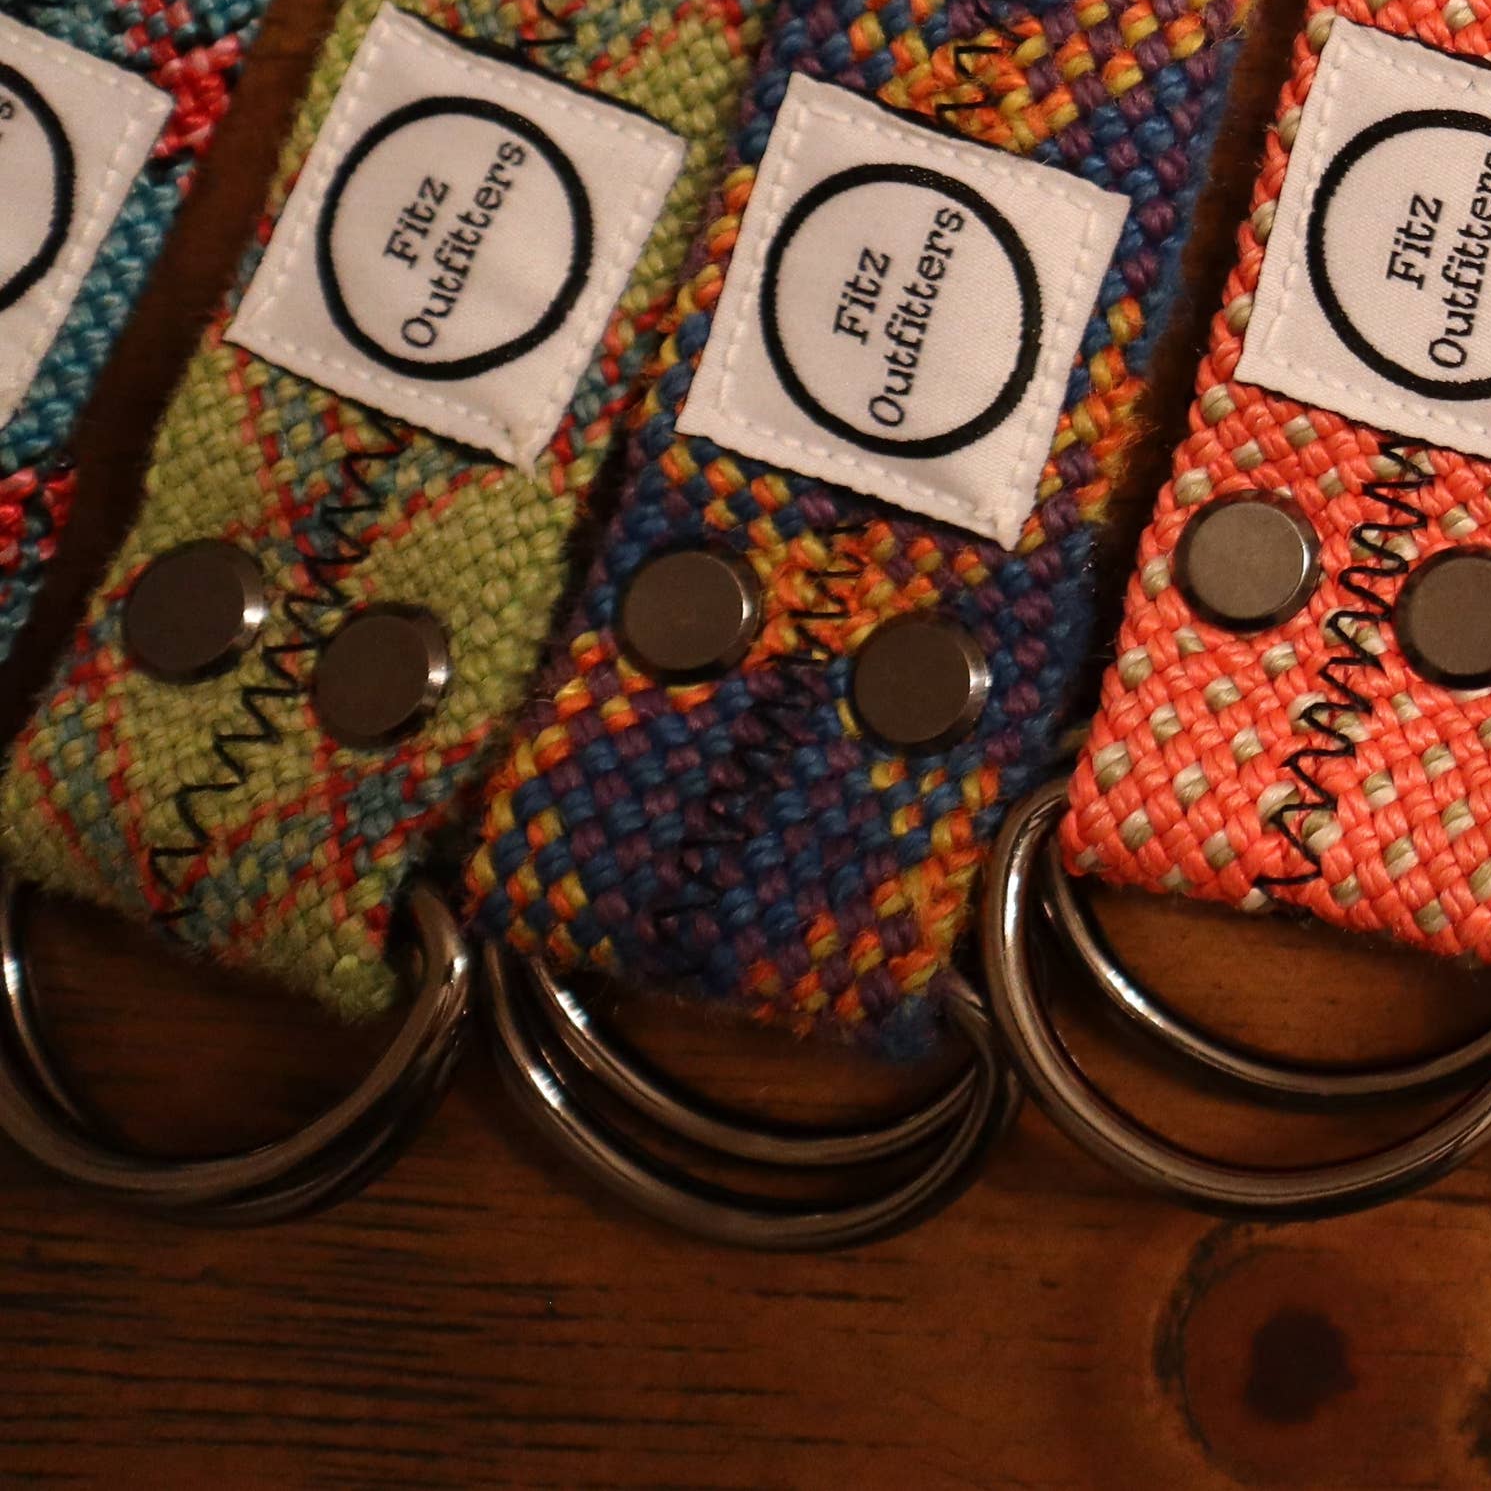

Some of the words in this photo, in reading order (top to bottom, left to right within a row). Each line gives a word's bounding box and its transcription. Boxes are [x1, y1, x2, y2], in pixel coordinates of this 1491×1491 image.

[382, 175, 452, 270] Fitz
[400, 140, 527, 350] Outfitters
[1386, 193, 1444, 291] Fitz
[832, 247, 890, 347] Fitz
[870, 207, 964, 428] Outfitters
